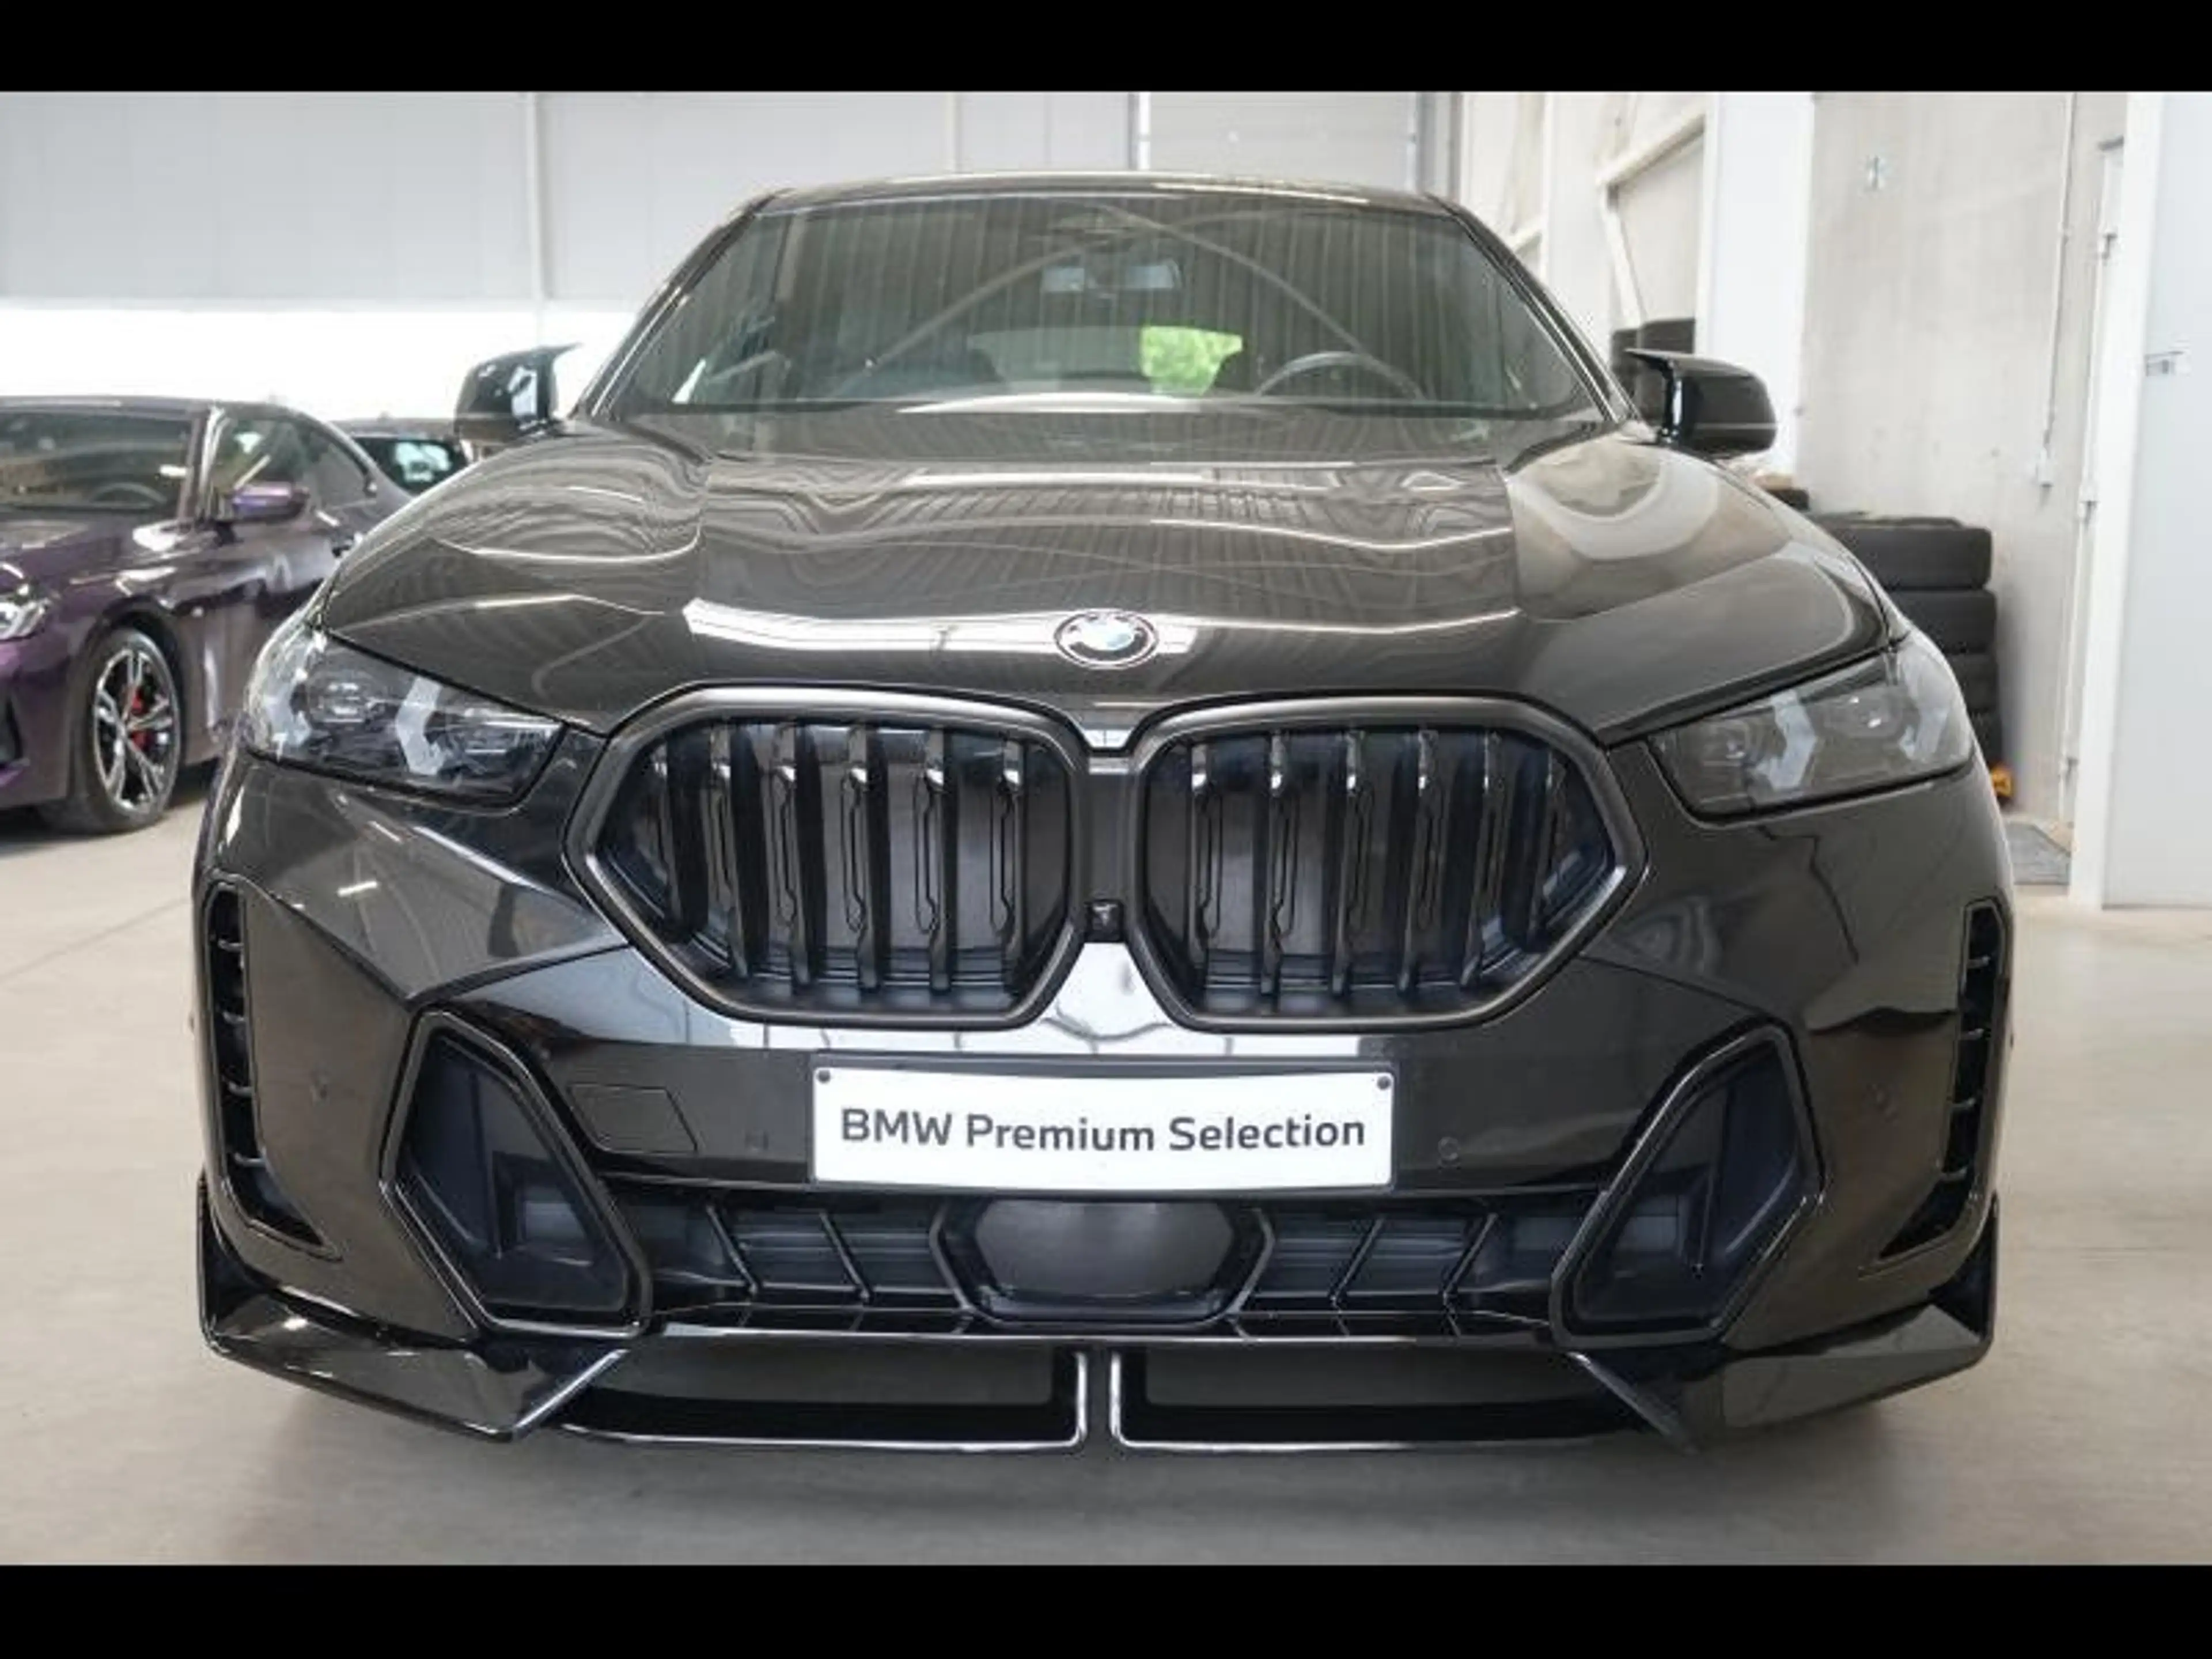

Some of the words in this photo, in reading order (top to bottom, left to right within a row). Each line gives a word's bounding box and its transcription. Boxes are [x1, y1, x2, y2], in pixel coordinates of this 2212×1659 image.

[841, 1108, 953, 1146] BMW
[967, 1113, 1155, 1152] Premium
[1169, 1113, 1365, 1152] Selection
